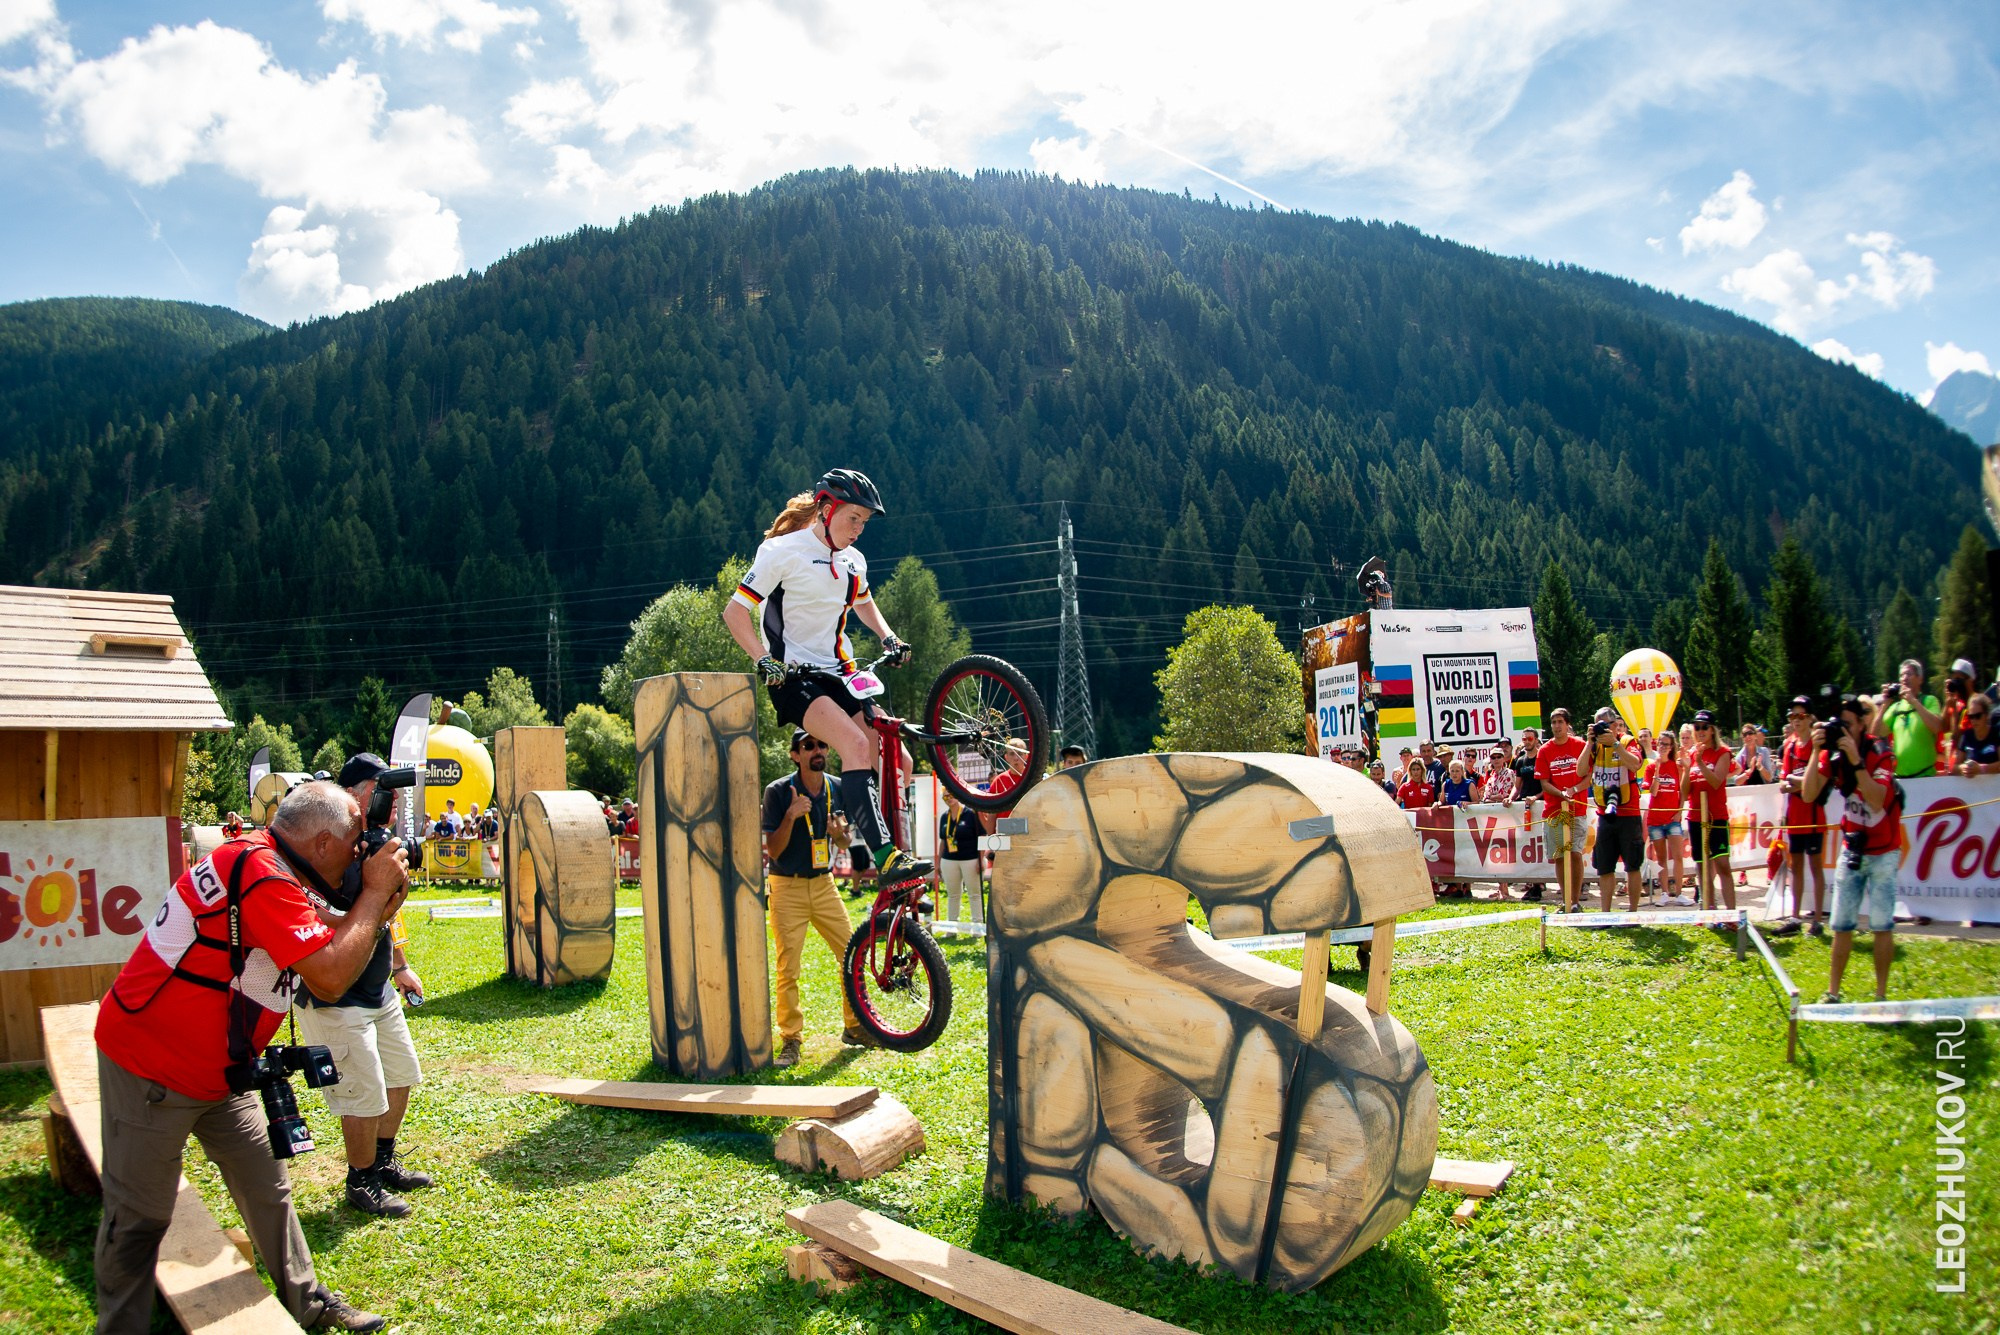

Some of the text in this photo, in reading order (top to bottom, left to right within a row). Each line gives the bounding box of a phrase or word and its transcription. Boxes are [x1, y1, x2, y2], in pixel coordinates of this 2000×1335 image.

[1444, 659, 1476, 667] MOUNTAIN
[1478, 658, 1491, 666] BIKE
[1325, 676, 1344, 687] MOUNTAIN
[1345, 673, 1355, 682] BIKE
[1432, 670, 1493, 691] WORLD
[1629, 677, 1646, 692] Val
[1647, 680, 1656, 689] di
[1655, 674, 1676, 688] Sole
[1332, 688, 1340, 697] CUP
[1341, 686, 1355, 696] FINALS
[1436, 694, 1493, 705] CHAMPIONSHIPS
[1319, 703, 1355, 738] 2017
[1440, 707, 1496, 738] 2016
[400, 725, 421, 755] 4
[425, 764, 460, 778] elinda
[1595, 772, 1620, 782] HOTO
[404, 786, 415, 841] rialsWorld
[1467, 816, 1516, 867] Val
[1521, 836, 1543, 863] di
[195, 860, 221, 901] UCI
[230, 905, 239, 946] Canon
